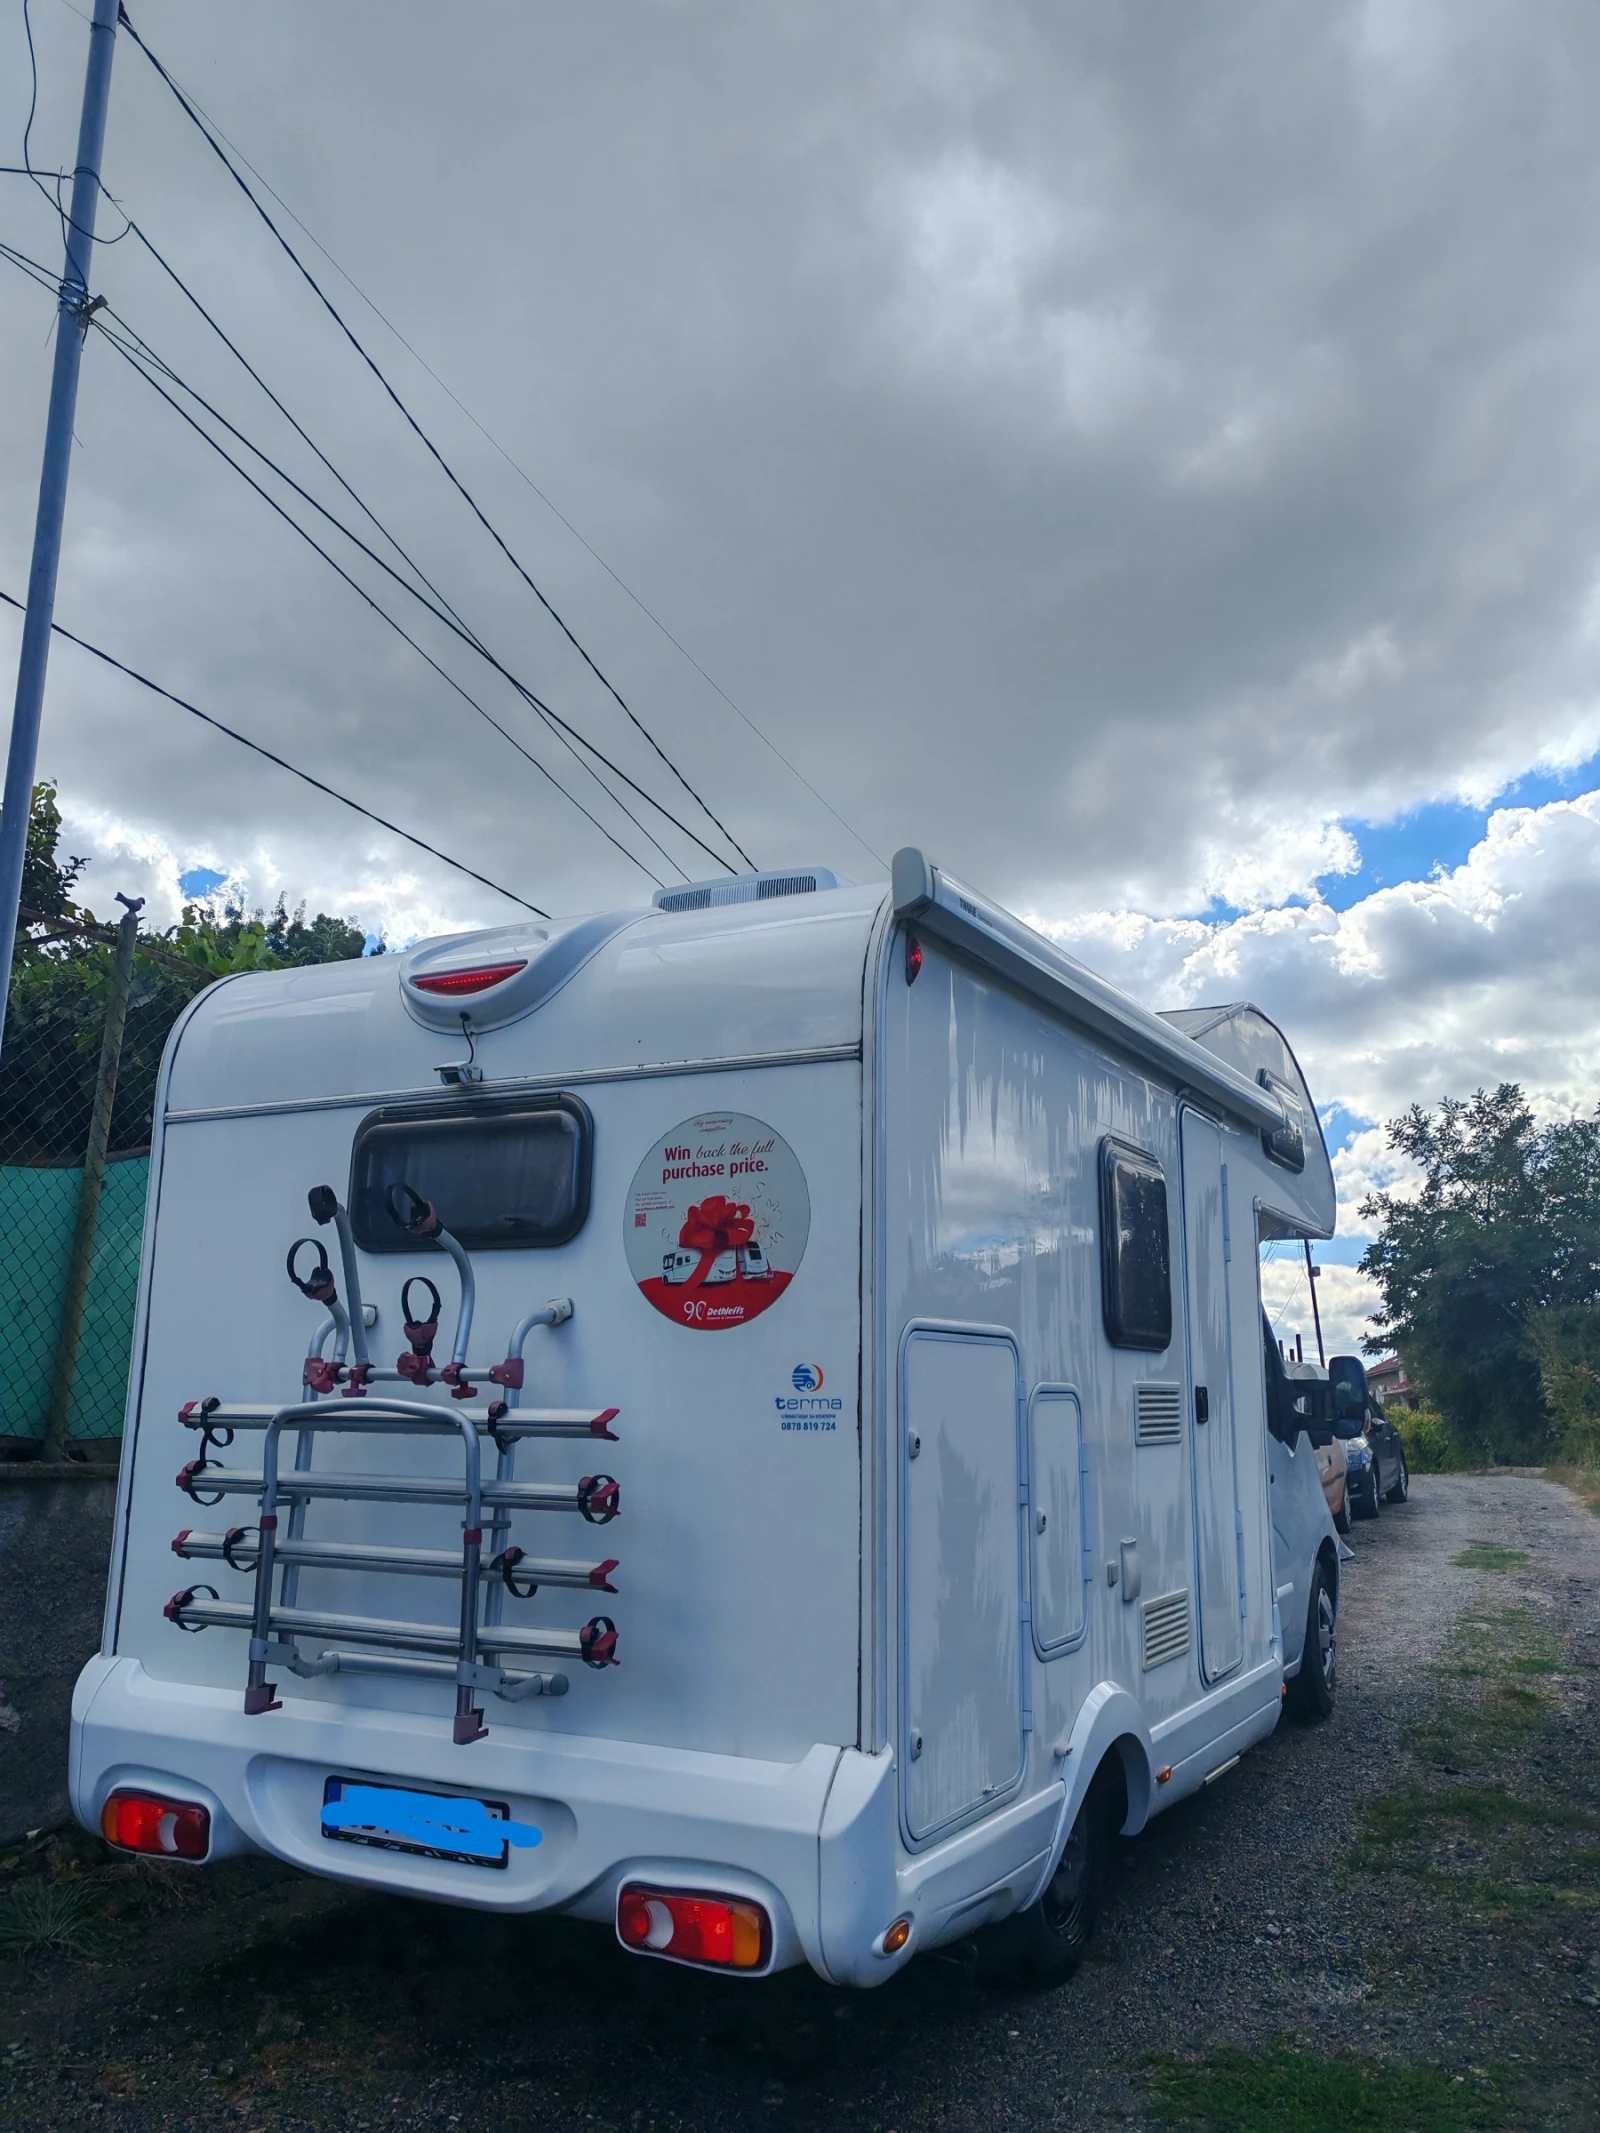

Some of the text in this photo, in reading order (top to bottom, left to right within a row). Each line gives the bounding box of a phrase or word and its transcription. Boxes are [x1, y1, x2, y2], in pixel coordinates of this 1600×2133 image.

[665, 1139, 775, 1161] Win back the full
[662, 1157, 769, 1184] purchase price.
[707, 1306, 745, 1316] Dethleffs
[775, 1397, 842, 1410] terma
[803, 1422, 819, 1431] 819
[820, 1422, 836, 1431] 724
